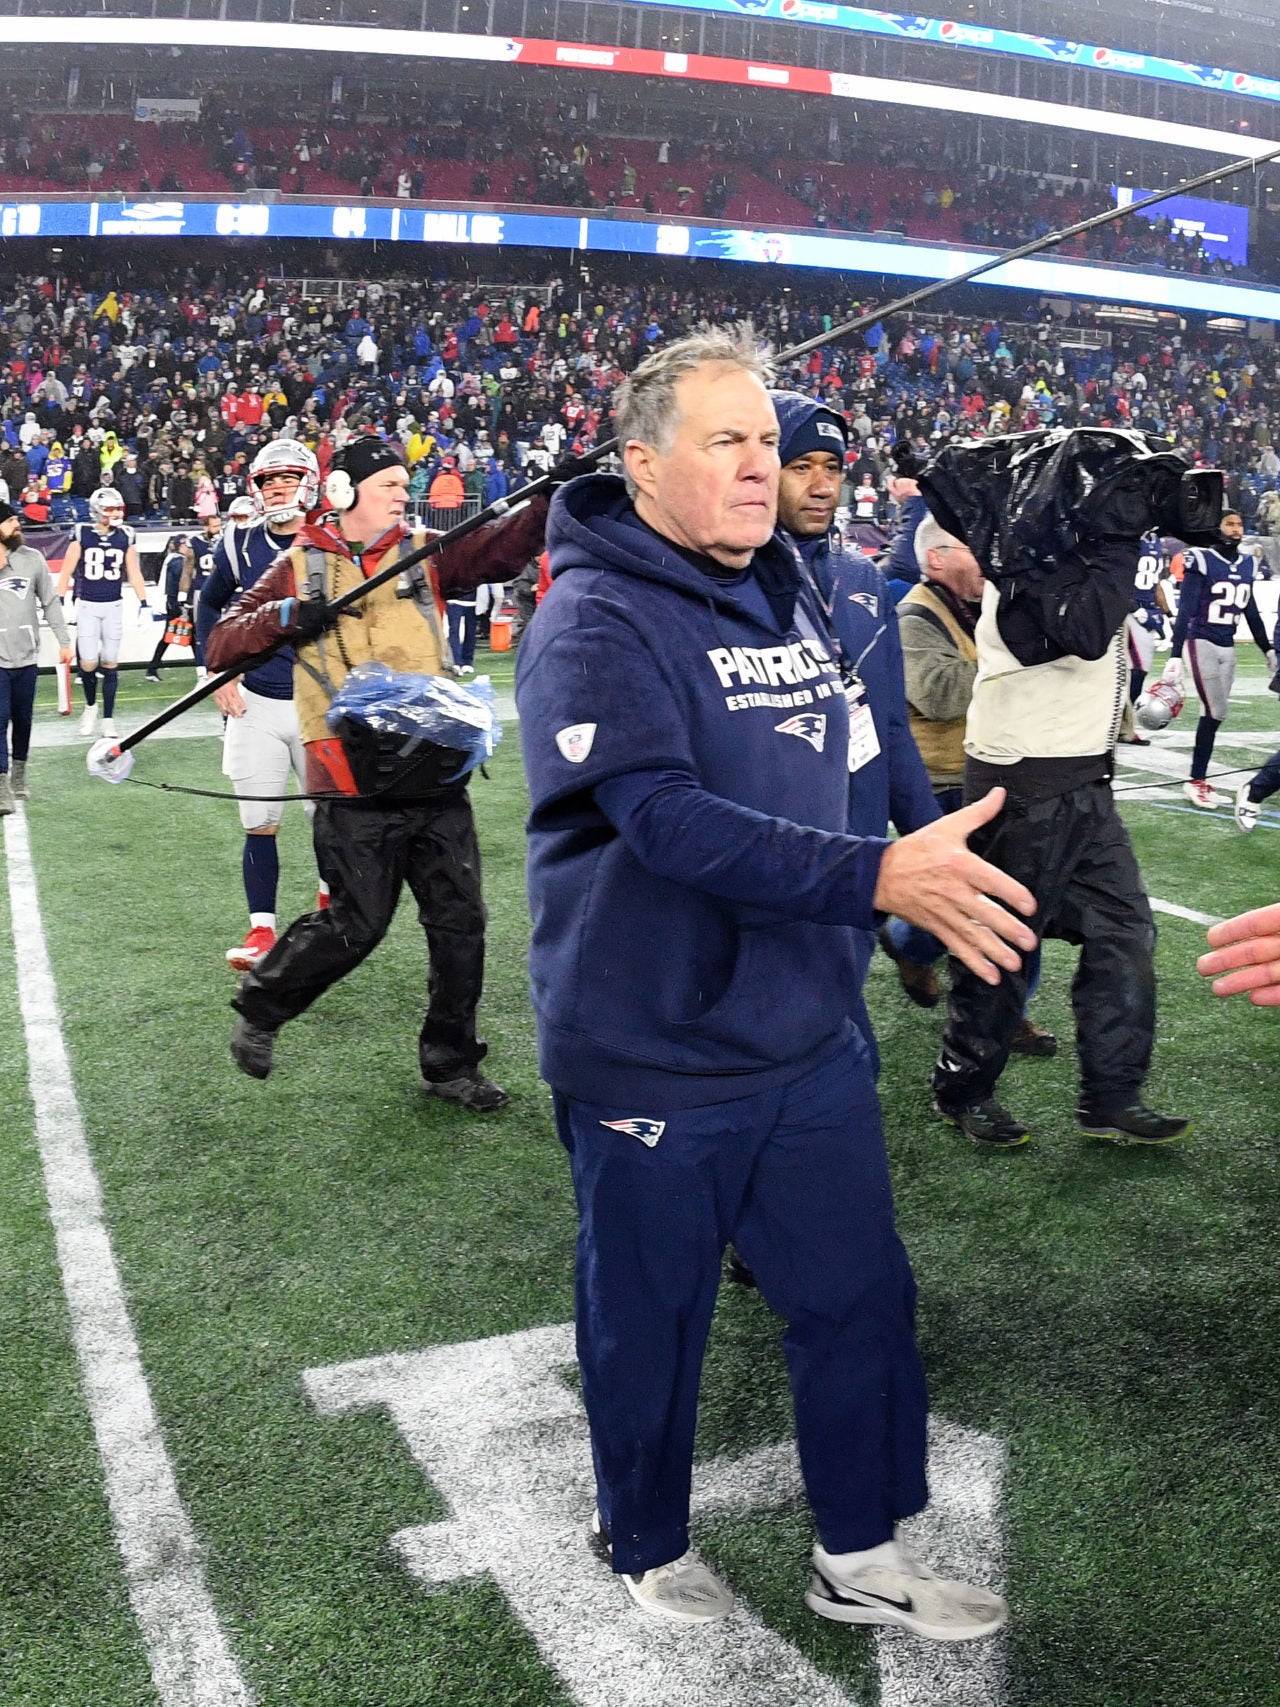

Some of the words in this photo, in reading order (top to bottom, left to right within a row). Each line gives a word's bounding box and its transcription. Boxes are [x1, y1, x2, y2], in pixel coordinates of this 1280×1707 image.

[222, 482, 237, 495] 12
[84, 547, 124, 580] 83
[1134, 556, 1163, 590] 8
[1207, 581, 1251, 625] 29
